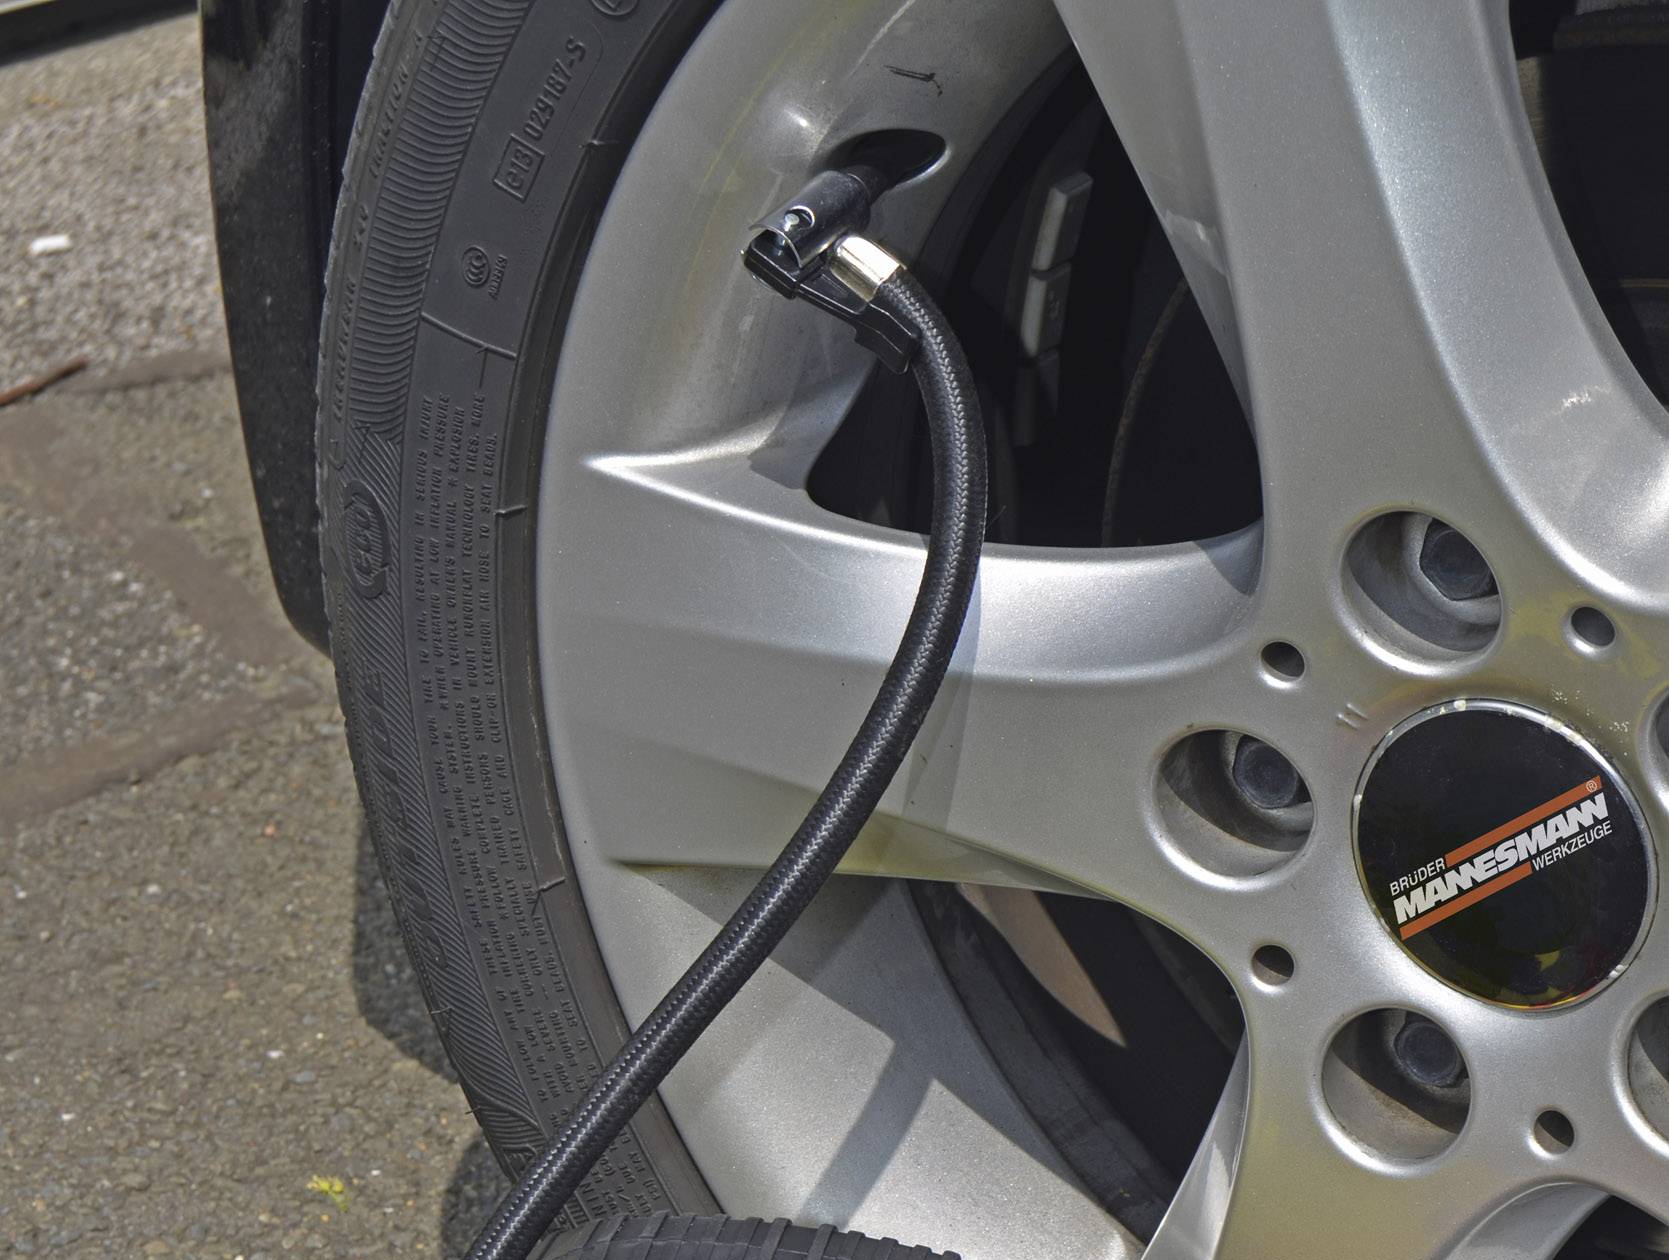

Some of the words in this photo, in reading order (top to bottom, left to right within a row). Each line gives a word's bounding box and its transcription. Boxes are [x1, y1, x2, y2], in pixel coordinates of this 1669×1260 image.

[506, 146, 534, 189] e13
[1393, 793, 1608, 924] MANNESMANN
[1532, 820, 1613, 873] WERKZEUGE
[1390, 858, 1446, 896] BRÜDER
